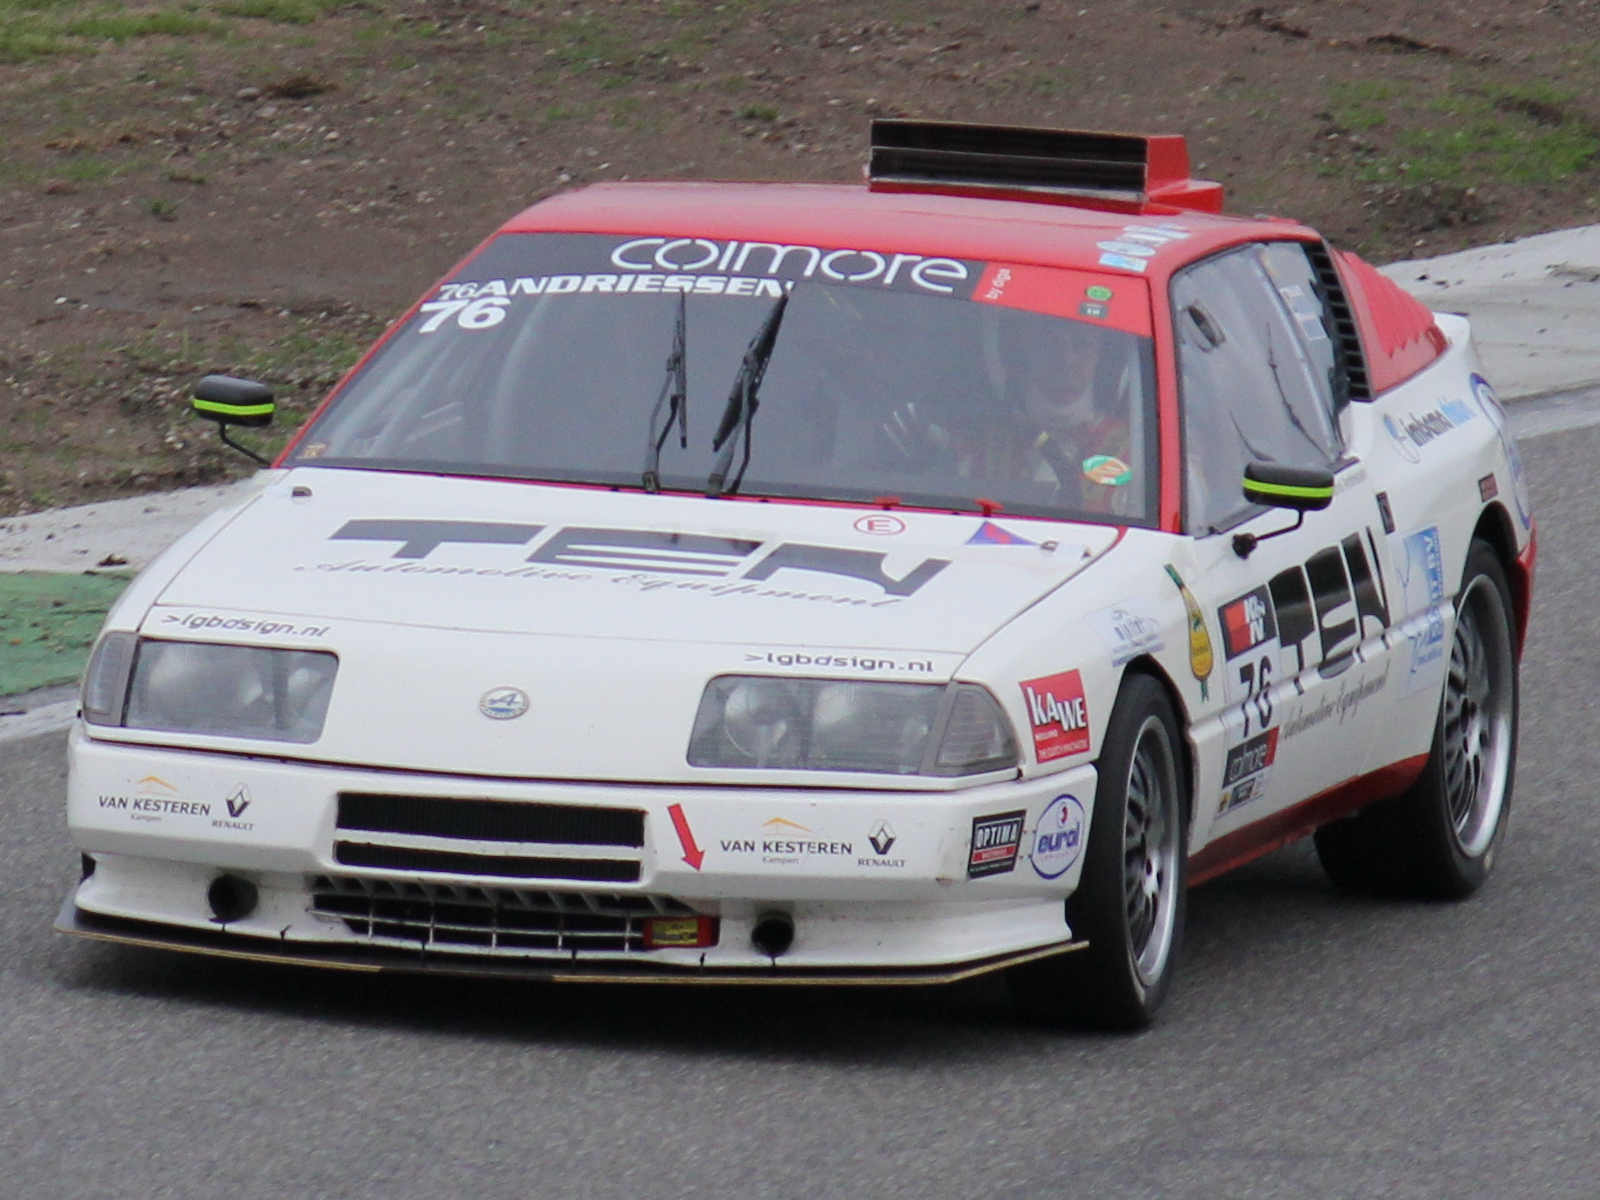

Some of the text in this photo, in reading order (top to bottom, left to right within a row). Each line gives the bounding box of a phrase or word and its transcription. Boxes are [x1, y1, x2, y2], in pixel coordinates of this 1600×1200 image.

[610, 237, 969, 294] colmore
[472, 273, 793, 300] ANDRIESSEN
[418, 297, 511, 334] 76
[328, 519, 953, 597] TEN
[1265, 524, 1392, 696] TEN
[1026, 686, 1087, 733] KAWE
[1239, 655, 1272, 738] 76
[98, 795, 212, 817] VAN KESTEREN
[211, 819, 255, 831] RENAULT
[976, 823, 1018, 848] OPTIMA
[719, 839, 853, 856] VAN KESTEREN
[857, 858, 907, 868] RENAULT
